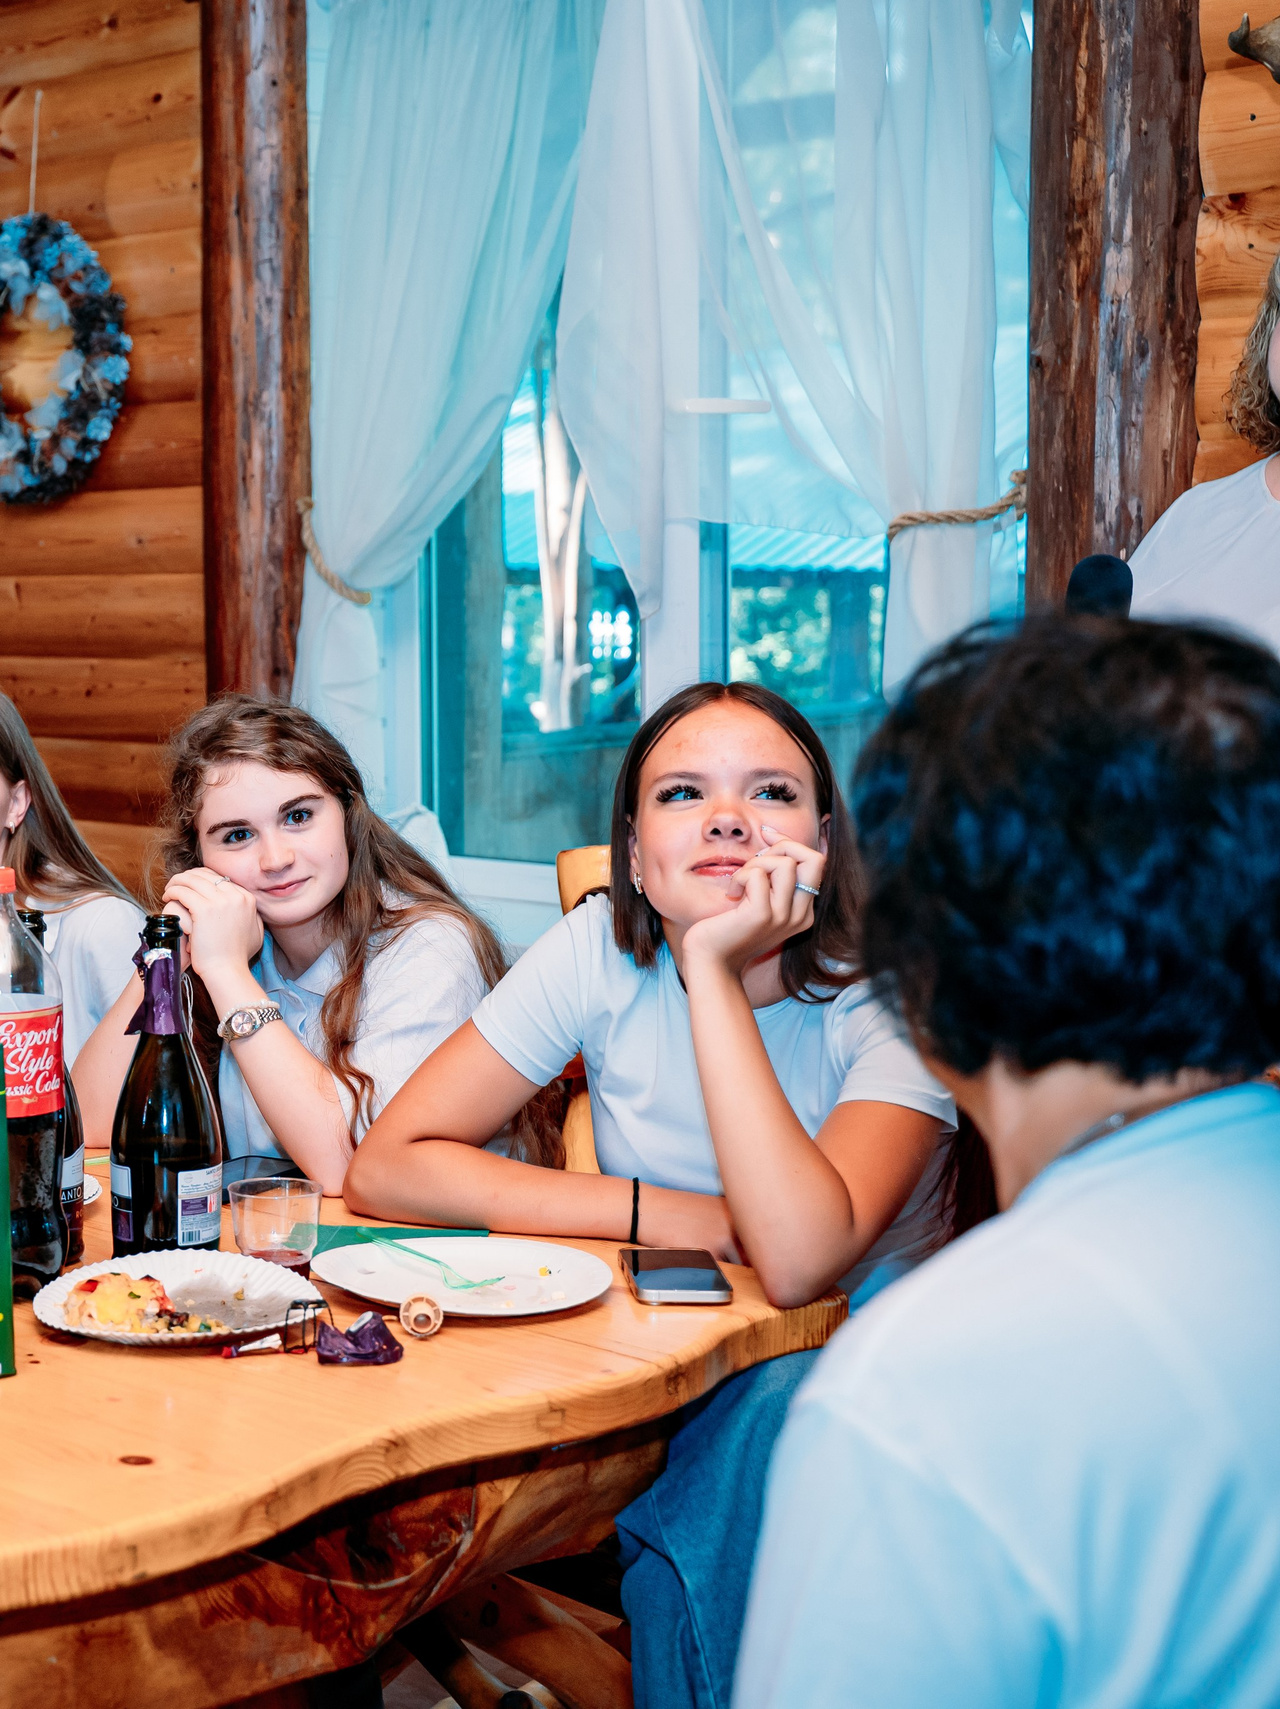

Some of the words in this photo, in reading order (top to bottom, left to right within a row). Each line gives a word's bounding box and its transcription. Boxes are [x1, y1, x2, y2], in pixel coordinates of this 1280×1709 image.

[4, 1046, 55, 1082] Style
[5, 1083, 33, 1097] assic
[35, 1071, 61, 1094] Cola
[61, 1186, 82, 1202] ANTO
